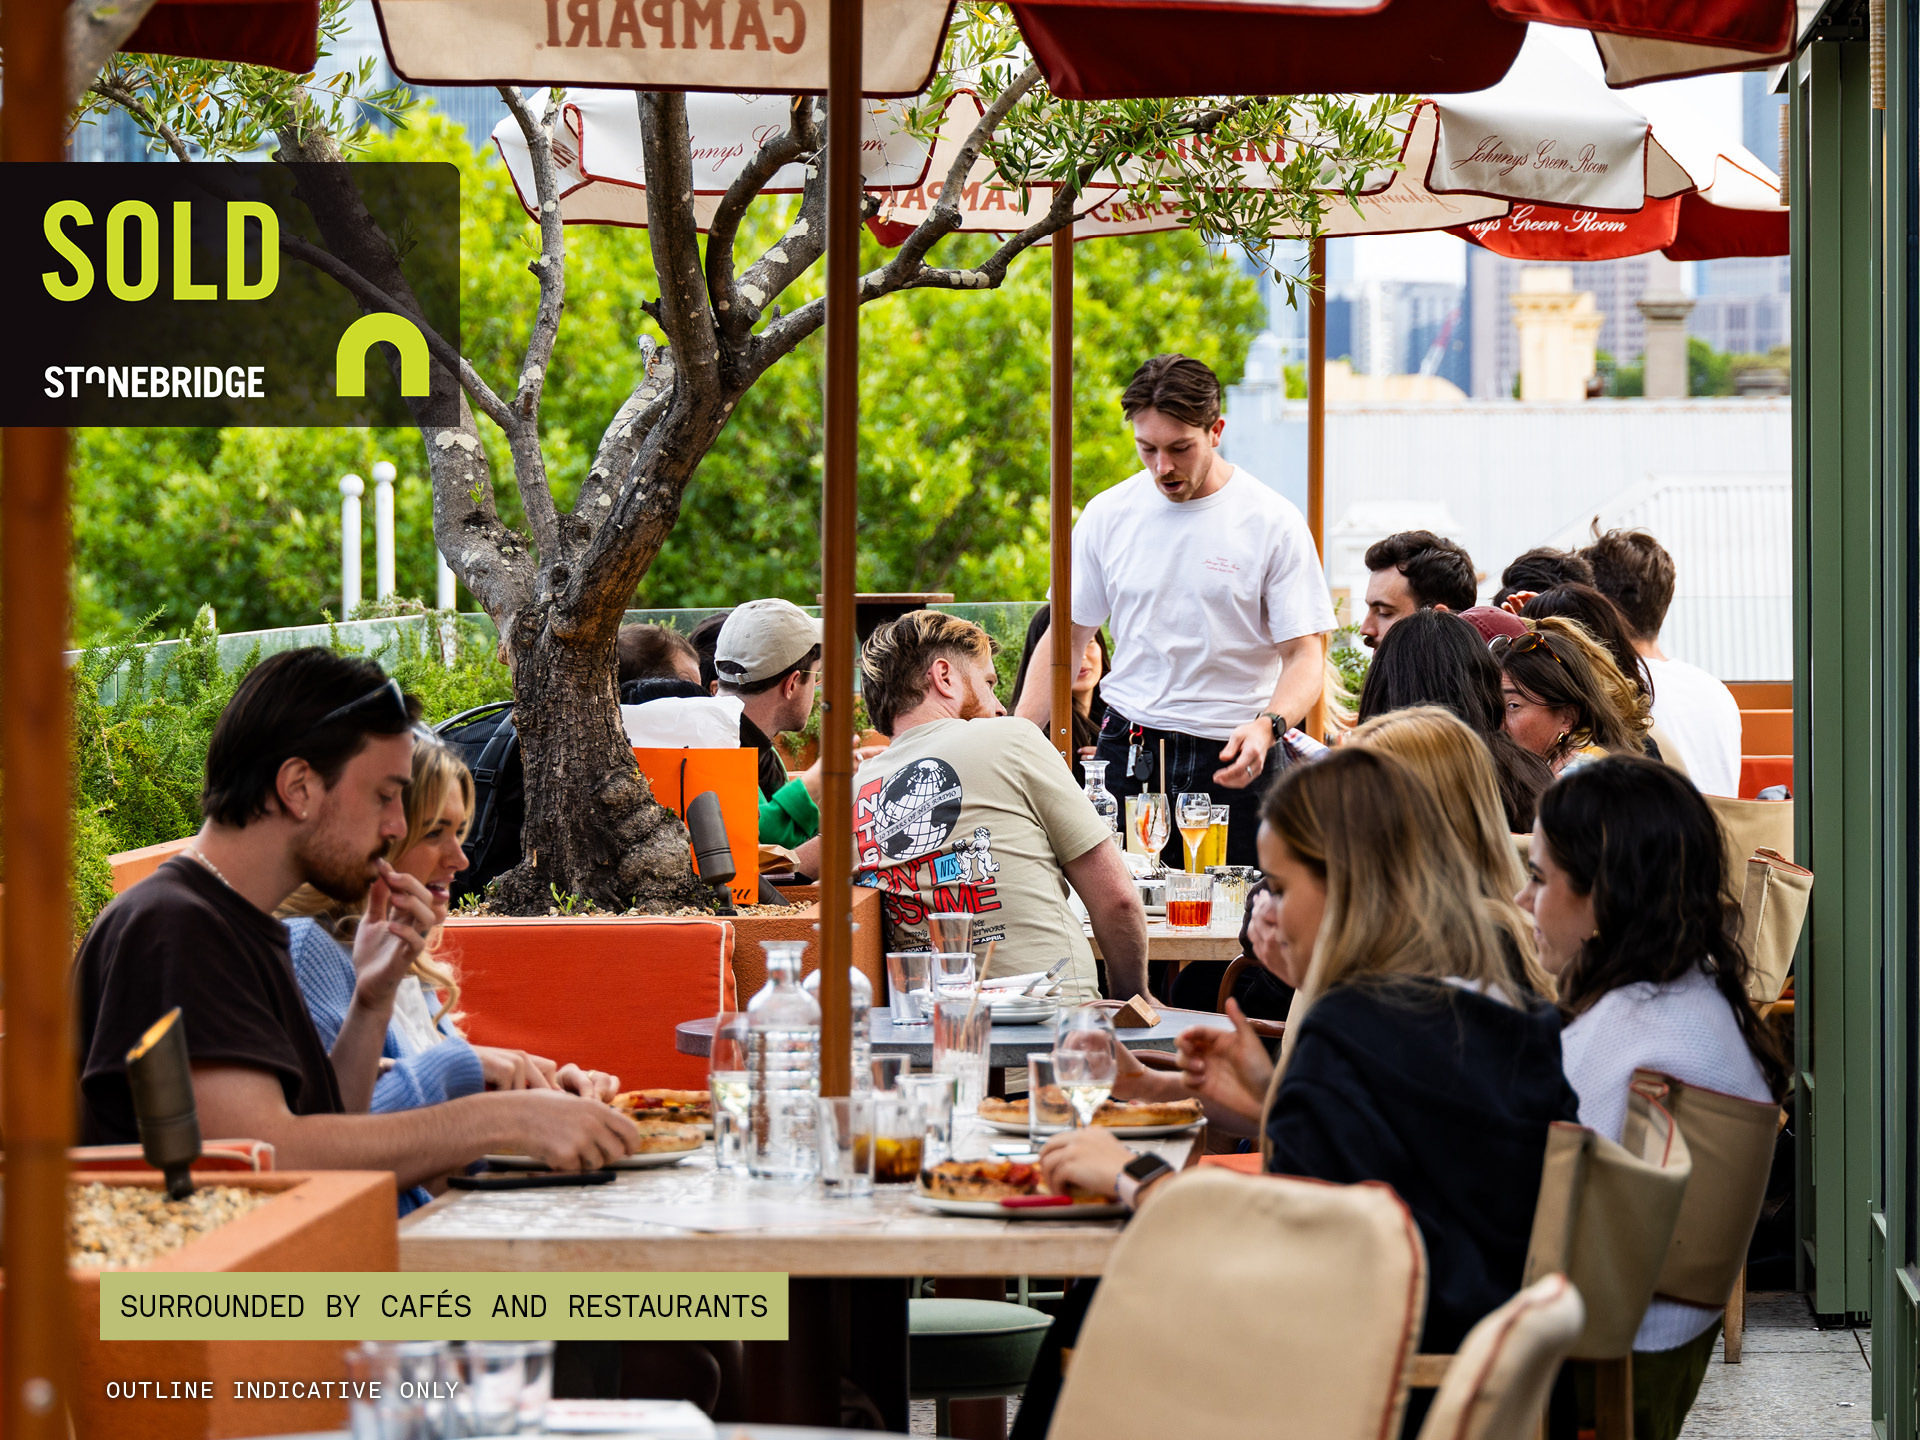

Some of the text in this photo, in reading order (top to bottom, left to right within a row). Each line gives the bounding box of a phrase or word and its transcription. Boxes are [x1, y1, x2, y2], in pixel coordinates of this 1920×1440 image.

[1450, 135, 1609, 176] Johnnys Green Room
[1508, 204, 1562, 232] Green
[1564, 209, 1627, 232] Room
[940, 857, 956, 878] NTS
[887, 876, 1003, 926] SSUME
[972, 923, 1006, 937] ETWORK
[980, 934, 1004, 943] APRIL
